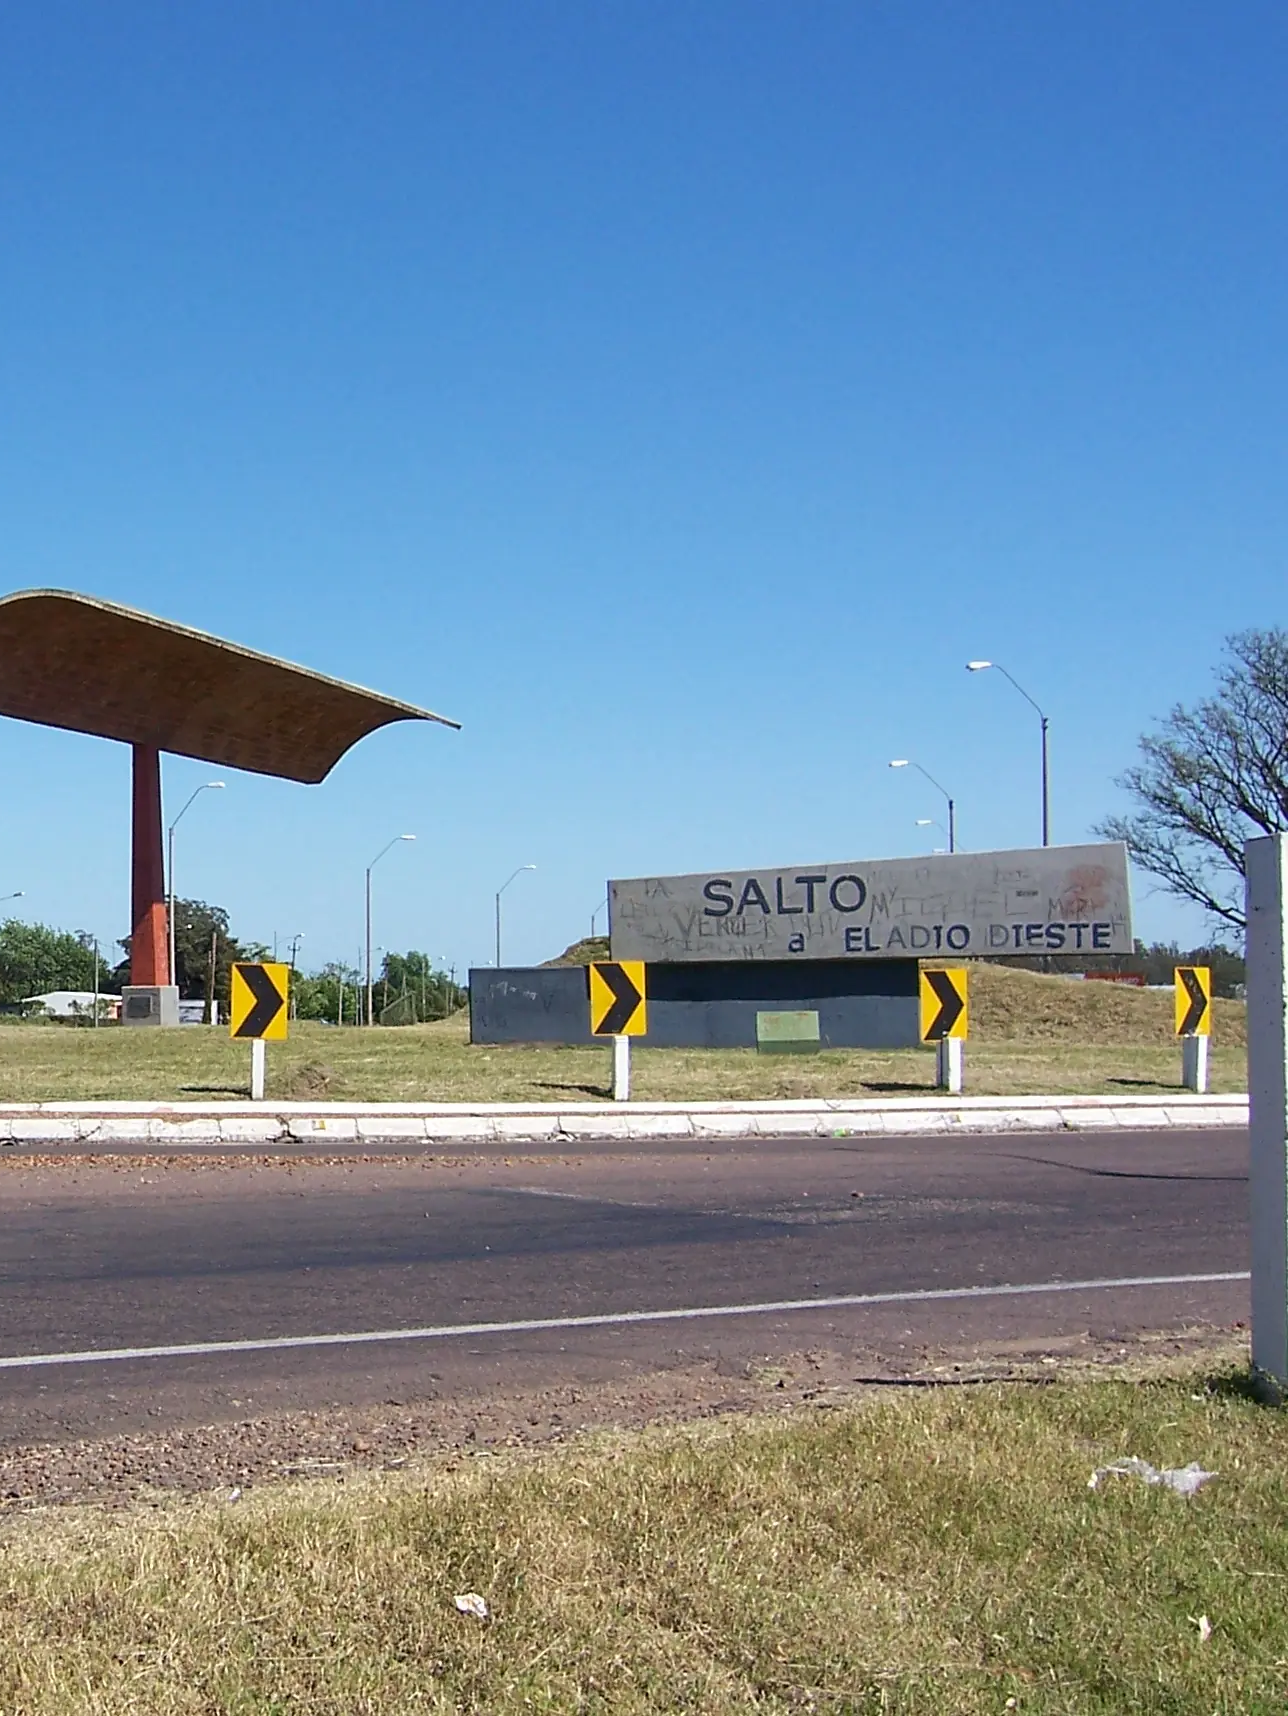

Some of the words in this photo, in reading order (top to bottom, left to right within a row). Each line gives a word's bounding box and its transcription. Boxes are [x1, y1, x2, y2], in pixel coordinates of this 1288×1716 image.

[703, 874, 868, 918] SALTO
[788, 929, 805, 953] a
[844, 923, 971, 953] ELADIO
[988, 922, 1111, 950] DIESTE
